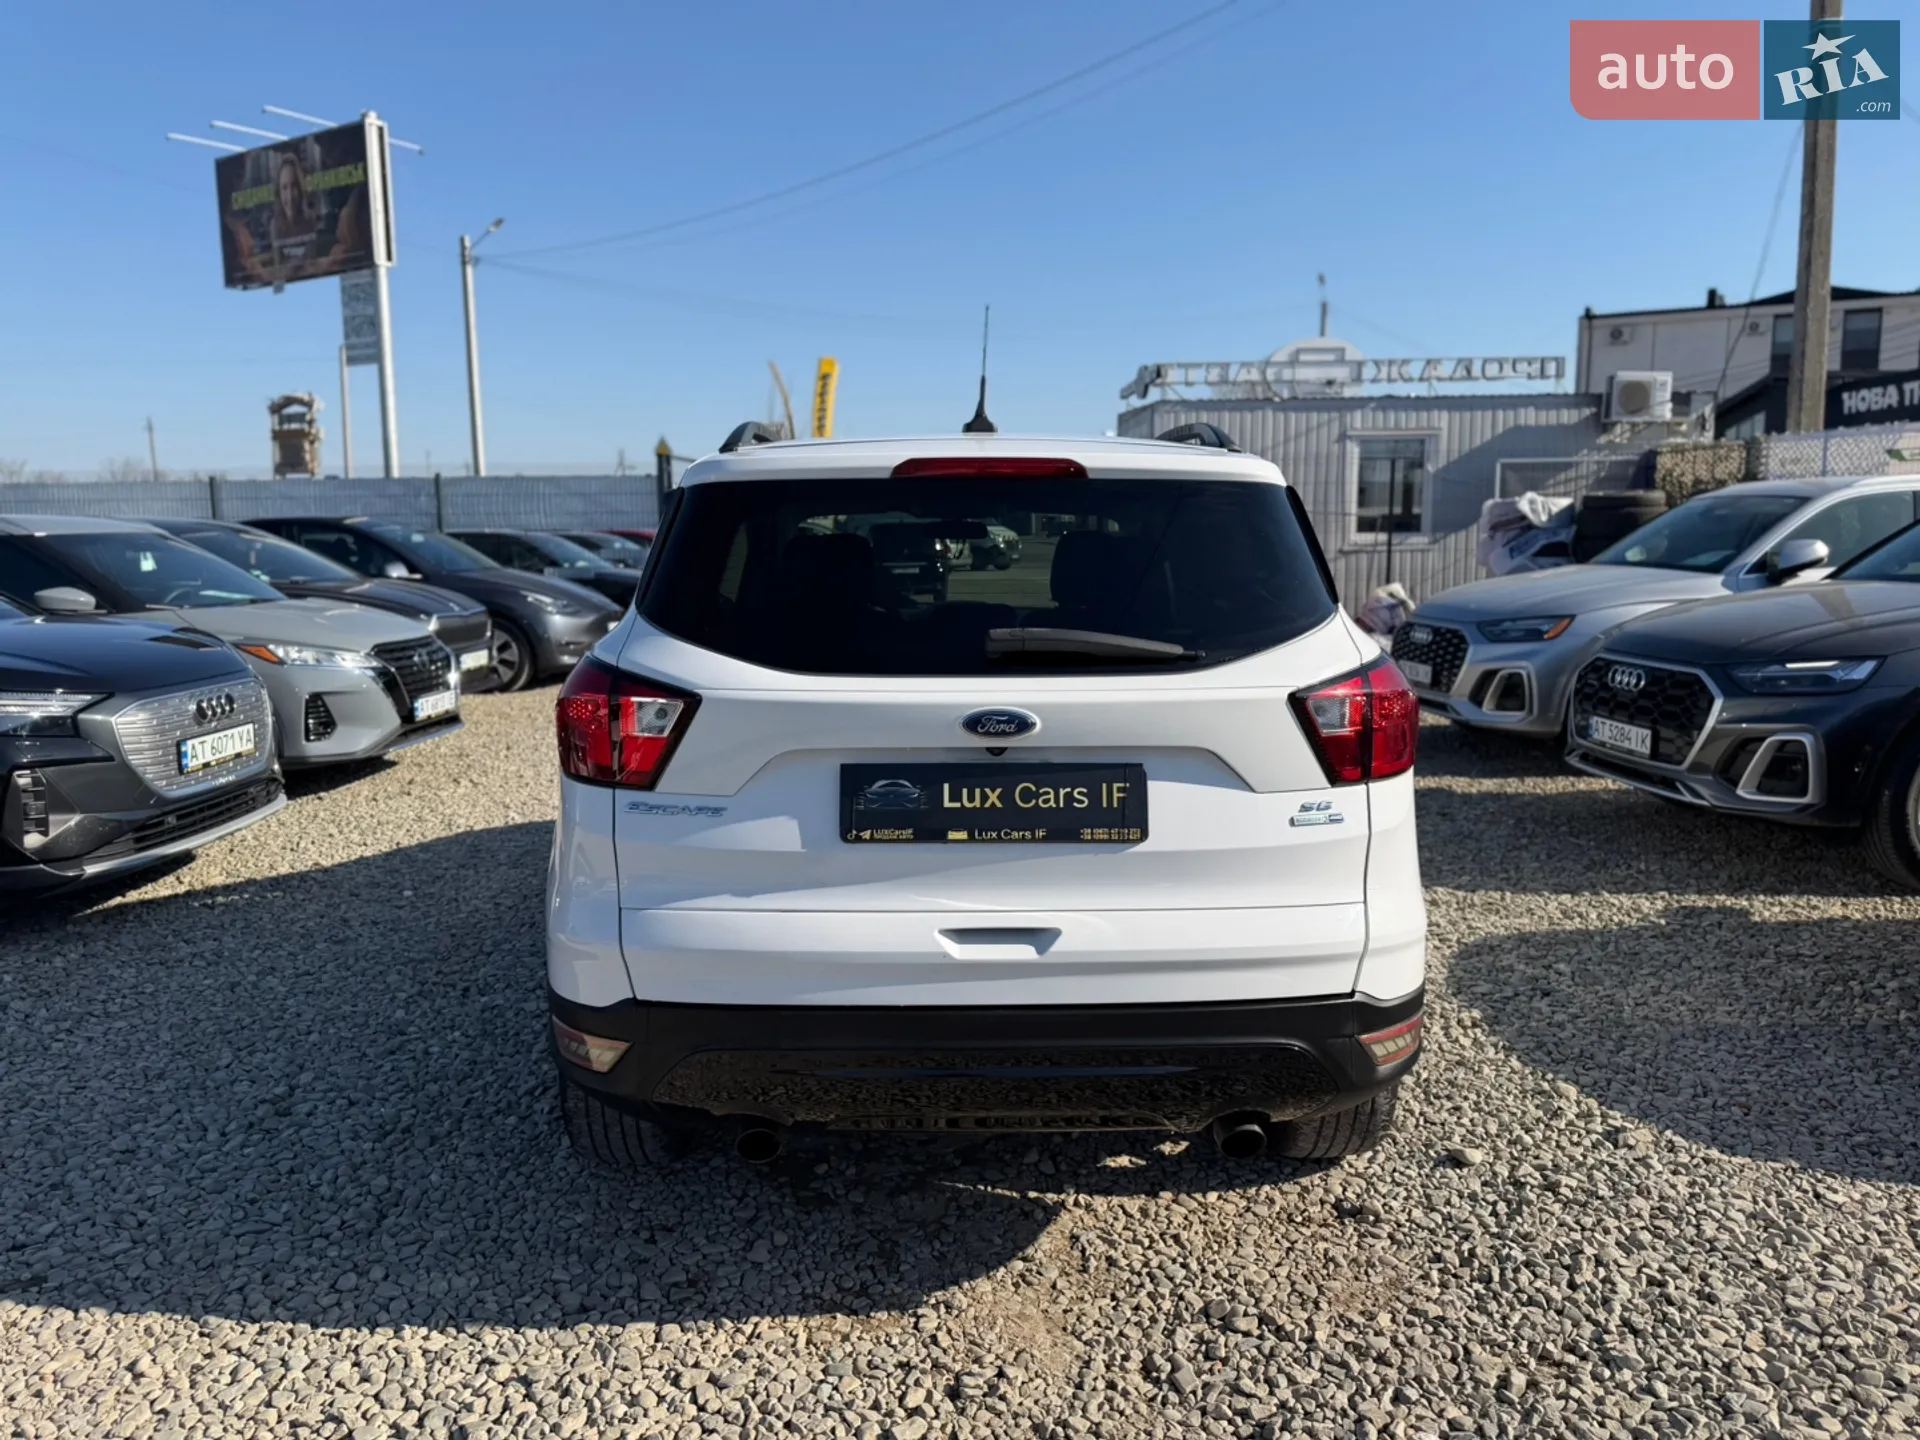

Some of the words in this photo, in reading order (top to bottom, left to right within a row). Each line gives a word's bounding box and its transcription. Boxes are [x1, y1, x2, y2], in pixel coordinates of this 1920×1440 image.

[1841, 384, 1900, 416] НОВА
[977, 715, 1018, 733] Ford
[1594, 719, 1607, 738] AT
[1608, 723, 1632, 746] 5284
[1635, 731, 1650, 751] IK
[190, 740, 208, 764] AT
[210, 733, 235, 756] 6071
[236, 727, 254, 749] YA
[943, 783, 1003, 809] Lux
[1014, 782, 1088, 809] Cars
[1102, 783, 1130, 808] IF
[624, 801, 728, 818] ESCAPE
[975, 829, 998, 840] Lux
[1000, 829, 1032, 840] Cars
[1035, 829, 1047, 839] IF
